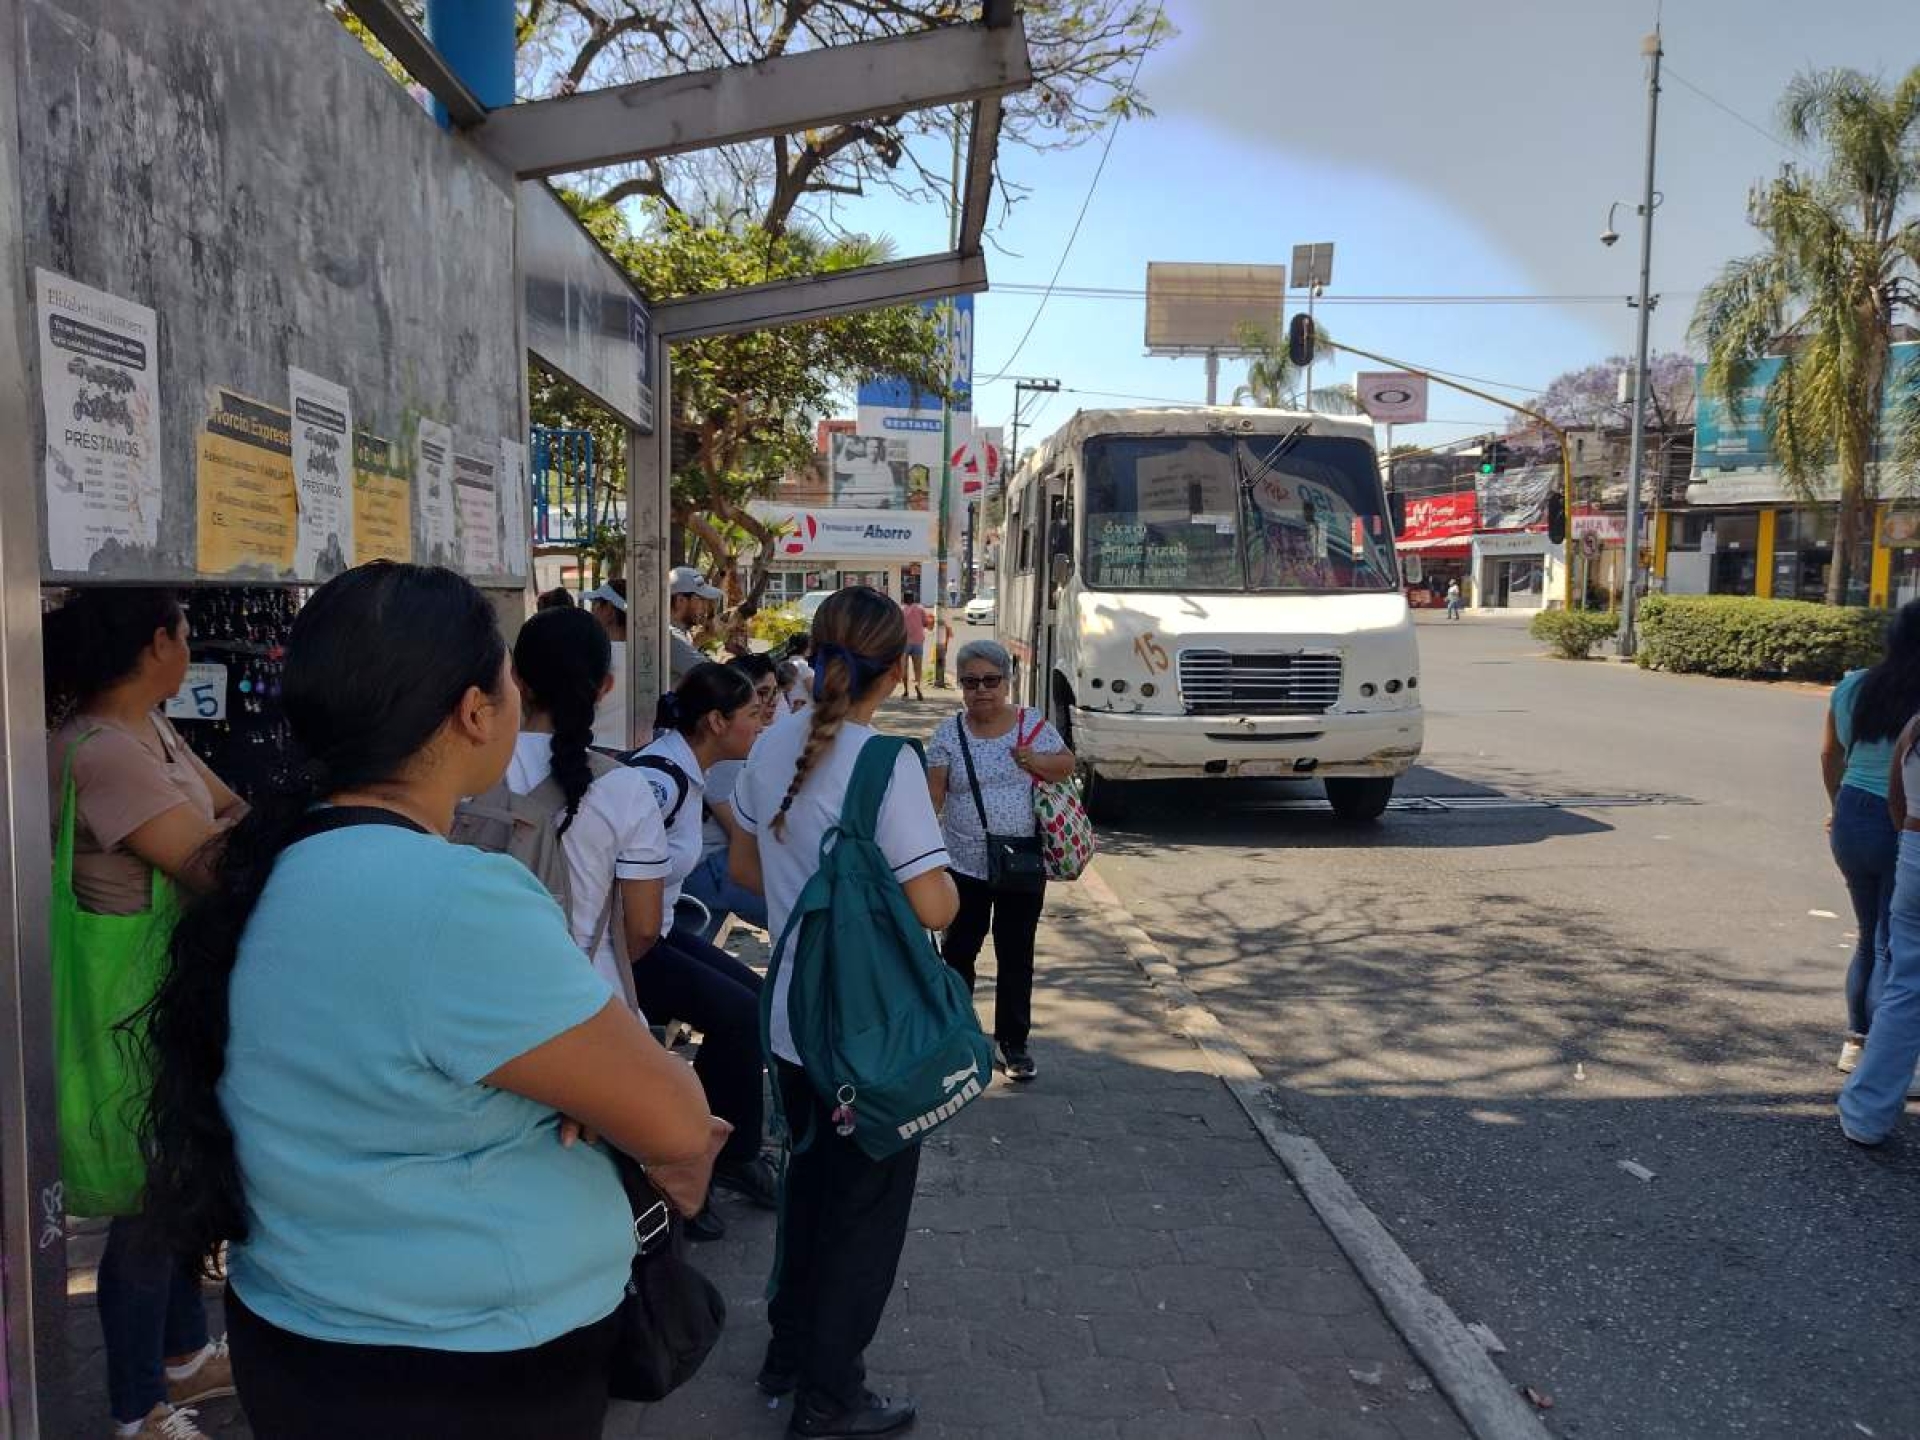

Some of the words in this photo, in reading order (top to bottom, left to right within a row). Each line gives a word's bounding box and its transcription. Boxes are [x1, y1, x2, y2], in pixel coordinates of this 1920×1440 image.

[863, 524, 912, 540] Ahorro
[1133, 631, 1169, 676] 15
[897, 1077, 981, 1140] PUMA
